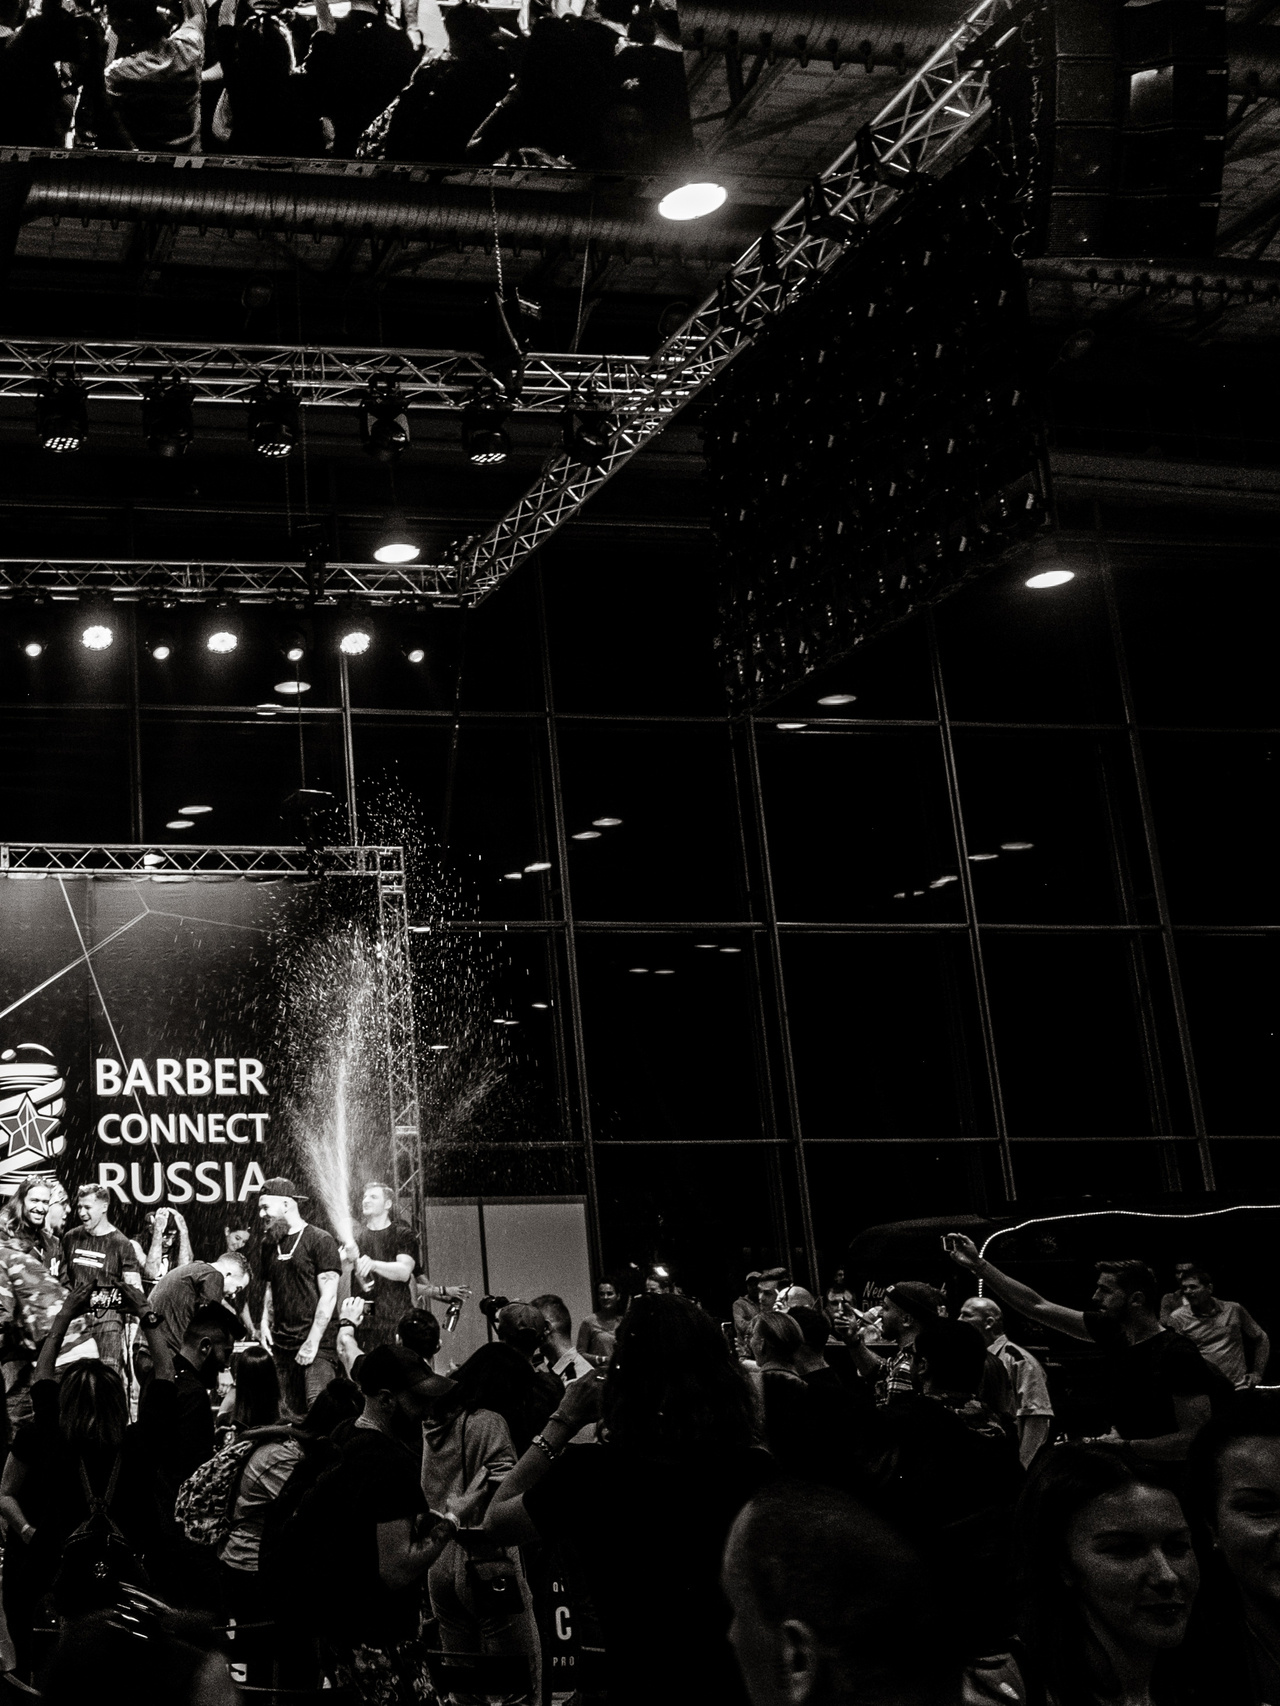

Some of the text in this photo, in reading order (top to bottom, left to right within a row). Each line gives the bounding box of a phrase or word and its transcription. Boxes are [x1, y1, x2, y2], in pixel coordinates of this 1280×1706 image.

[95, 1057, 270, 1097] BARBER
[97, 1113, 270, 1145] CONNECT
[98, 1161, 267, 1204] RUSSIA
